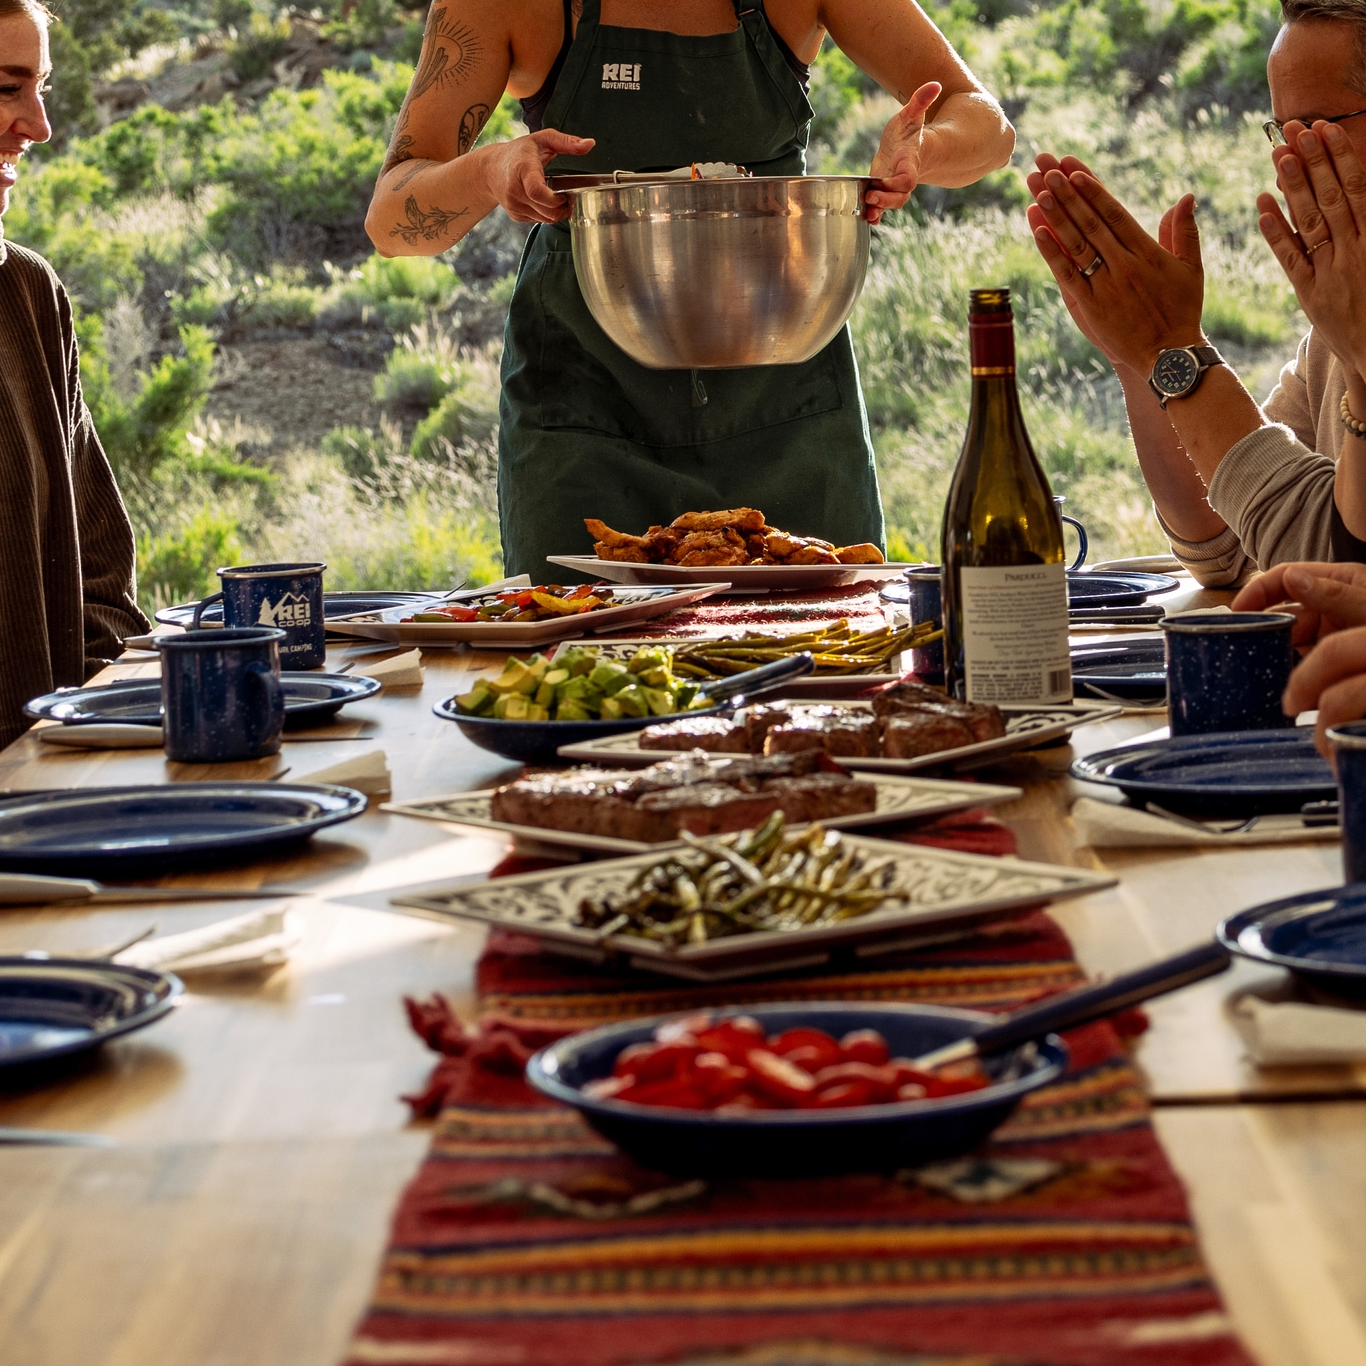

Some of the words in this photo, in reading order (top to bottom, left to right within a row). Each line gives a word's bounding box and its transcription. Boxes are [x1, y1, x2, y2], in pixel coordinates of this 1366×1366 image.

[602, 63, 641, 81] REI
[601, 81, 641, 91] ADVENTURES
[278, 602, 311, 621] REI
